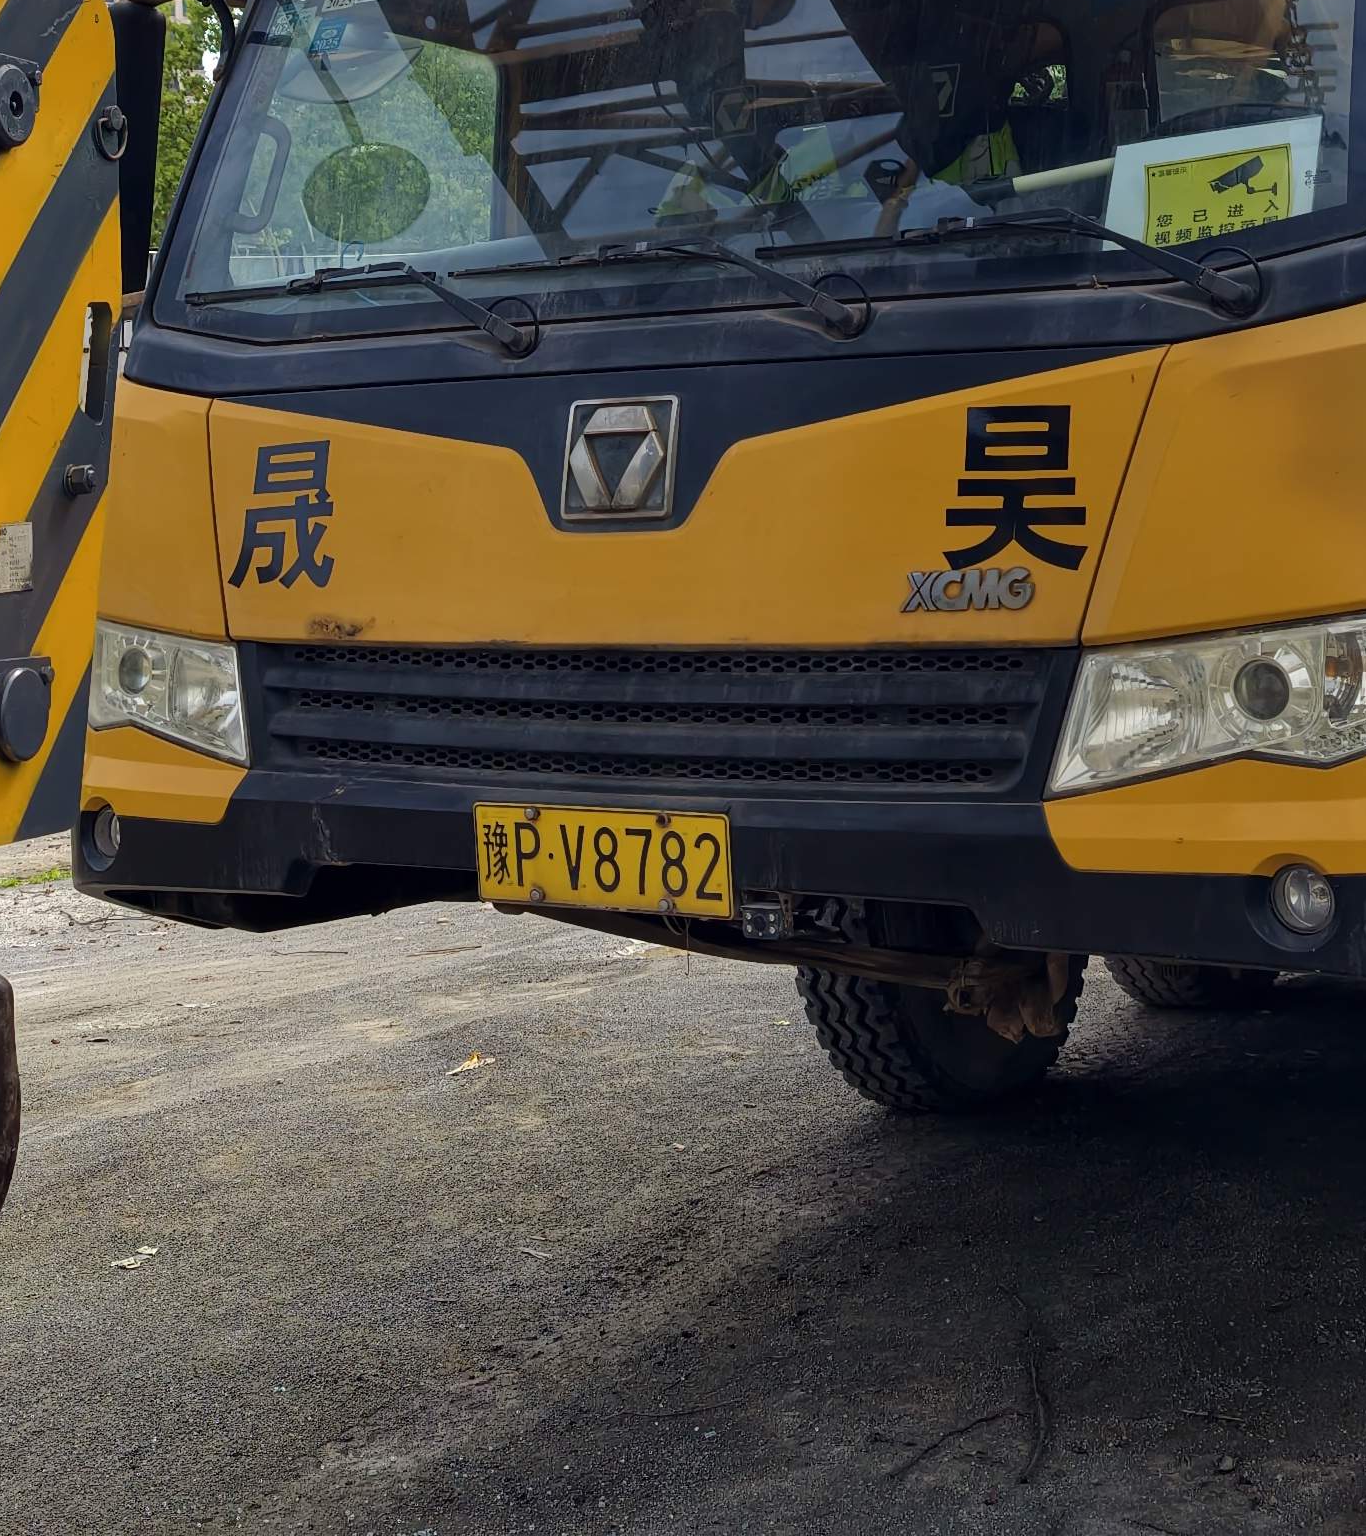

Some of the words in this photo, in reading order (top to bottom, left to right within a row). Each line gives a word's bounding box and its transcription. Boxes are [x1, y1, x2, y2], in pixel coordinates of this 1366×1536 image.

[227, 439, 335, 590] 晟
[941, 404, 1090, 571] 昊
[899, 566, 1035, 613] XCMG
